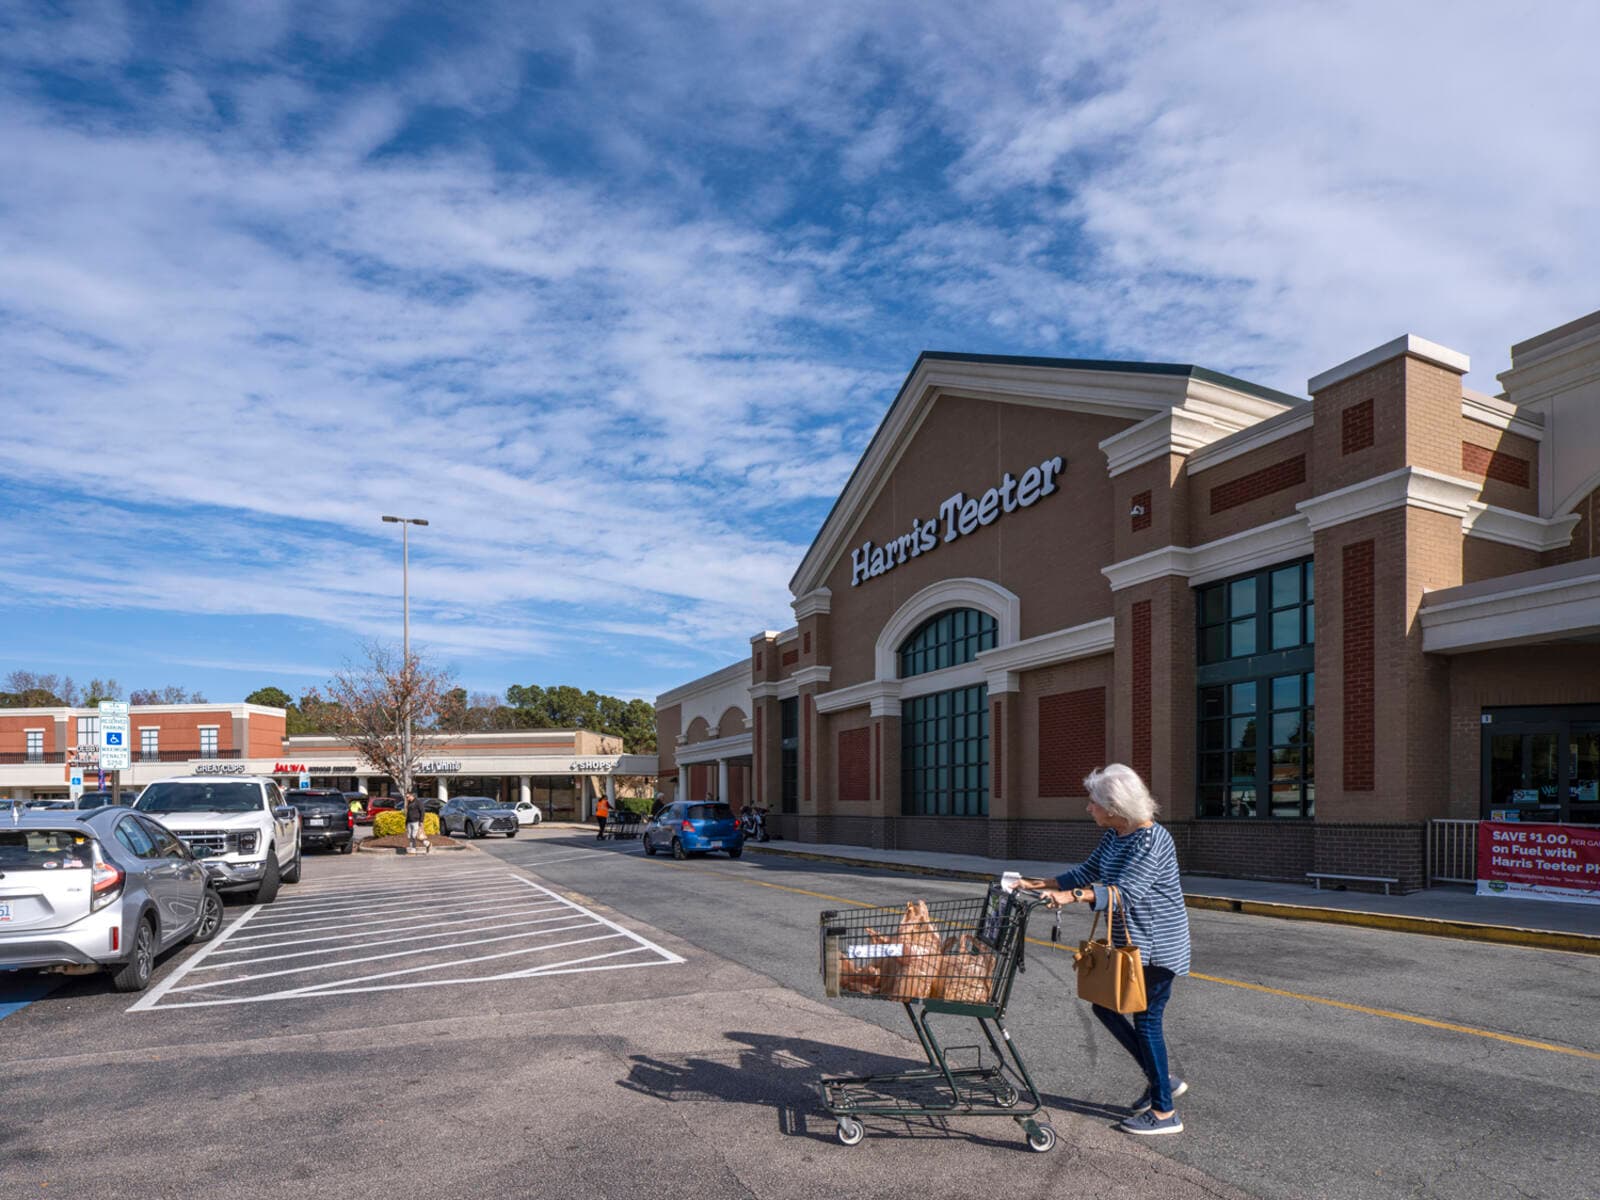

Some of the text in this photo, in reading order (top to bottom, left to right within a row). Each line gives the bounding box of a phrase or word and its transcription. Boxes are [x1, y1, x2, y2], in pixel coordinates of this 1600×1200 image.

[851, 456, 1063, 587] Harris Teeter
[196, 764, 222, 773] GREAT
[580, 760, 612, 769] SHOPS
[1492, 831, 1527, 842] SAVE
[1529, 832, 1568, 844] $1.00
[1492, 845, 1577, 859] on Fuel with
[1492, 856, 1533, 869] Harris
[1536, 859, 1583, 872] Teeter
